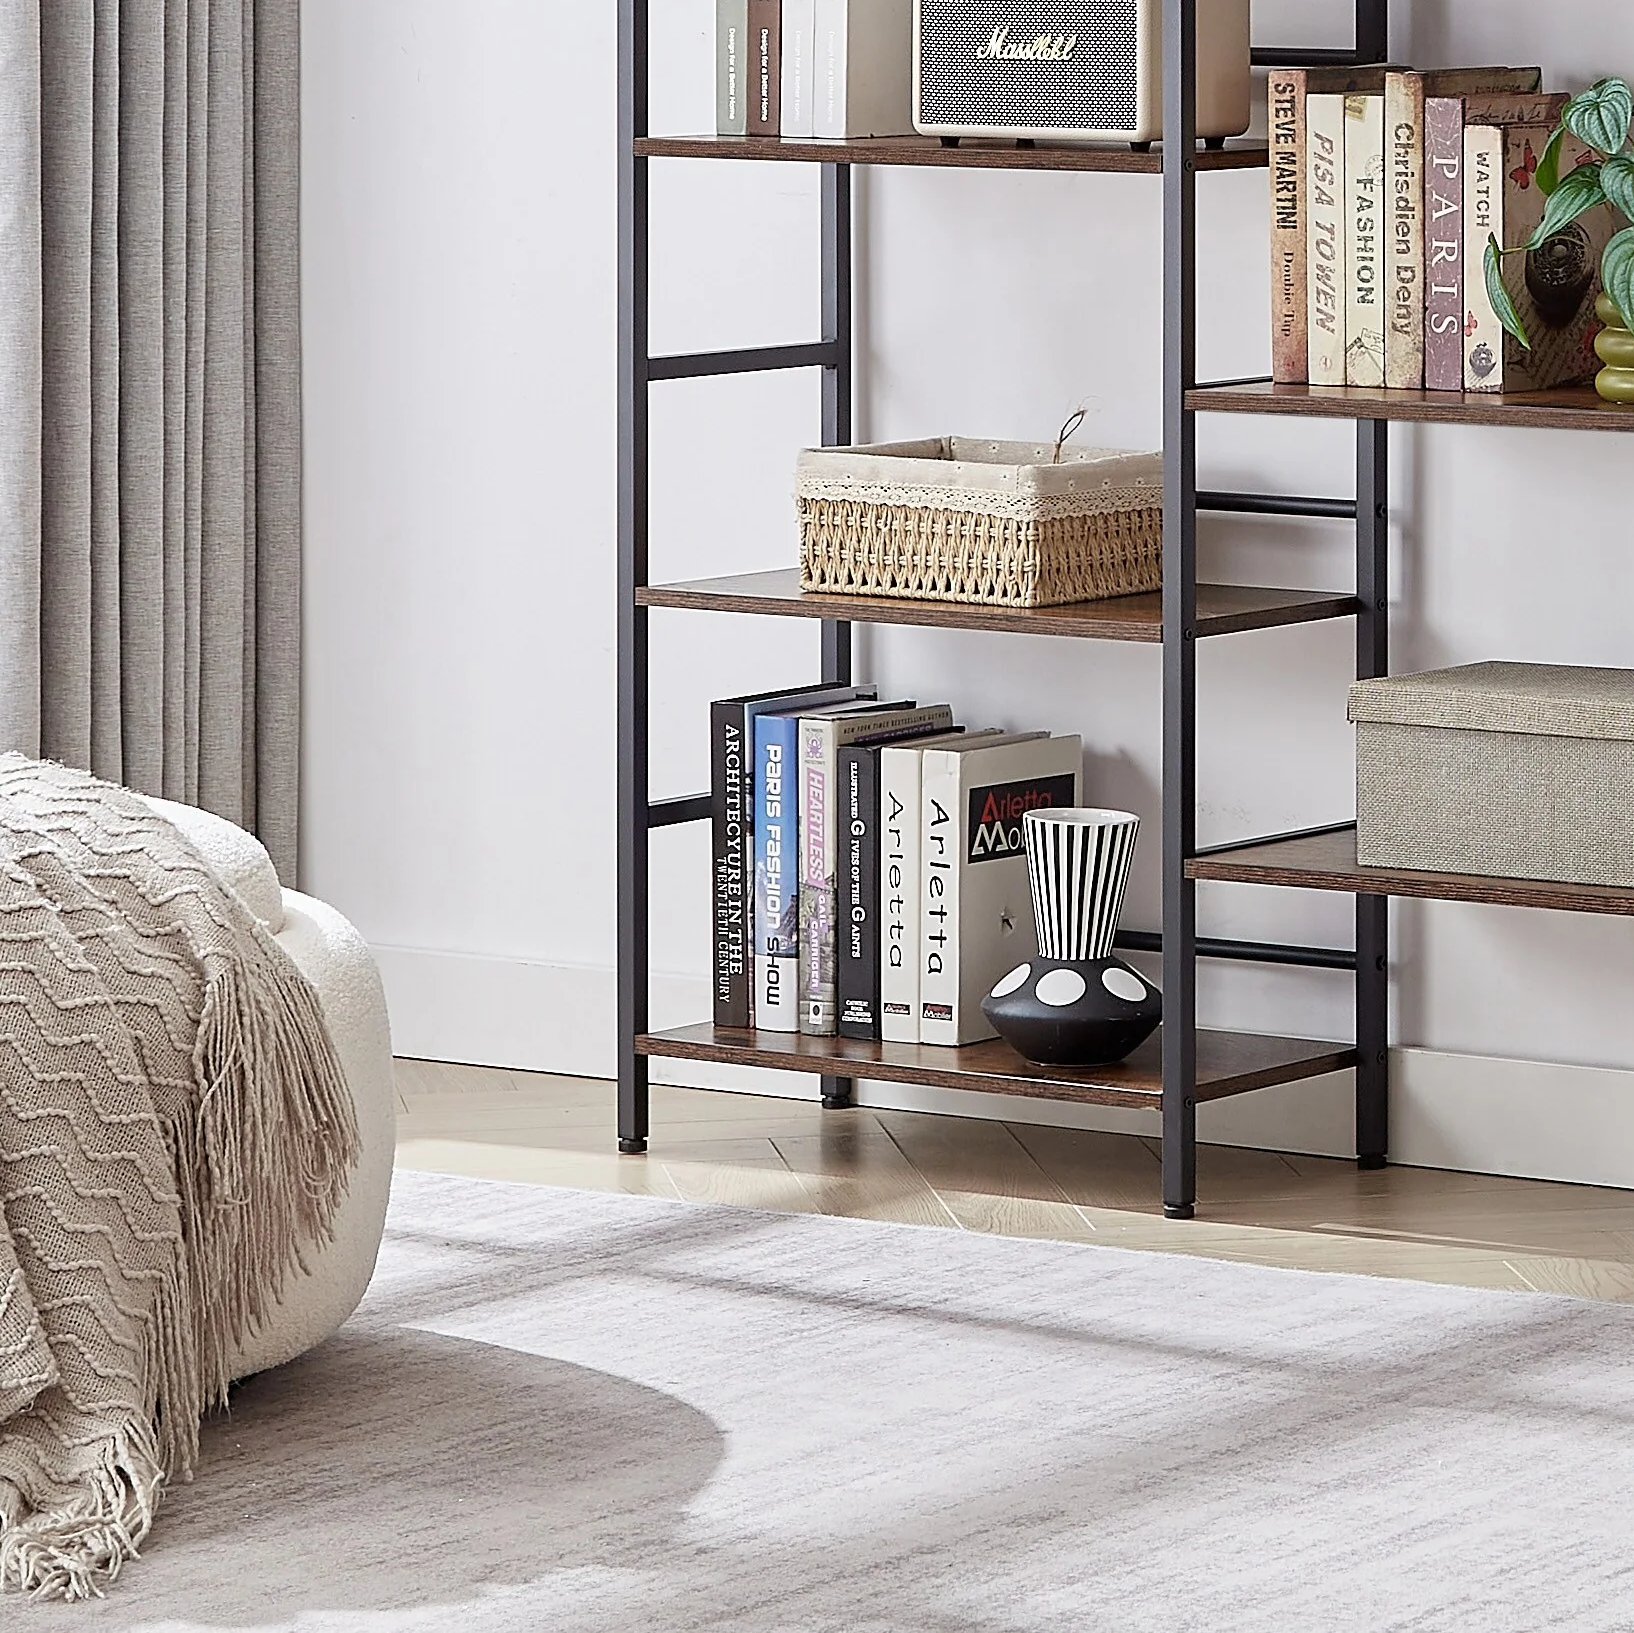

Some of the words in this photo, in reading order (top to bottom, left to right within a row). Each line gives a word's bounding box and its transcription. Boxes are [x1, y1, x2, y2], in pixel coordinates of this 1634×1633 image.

[728, 27, 736, 54] Design
[760, 28, 768, 56] Design
[1273, 82, 1296, 145] STEVE
[1275, 151, 1298, 230] MARTINI
[1313, 130, 1335, 207] PISA
[1394, 122, 1415, 255] Chrisdien
[1476, 151, 1490, 228] WATCH
[1356, 178, 1375, 305] FASHION
[1430, 154, 1459, 335] PARIS
[1391, 265, 1416, 337] Deny
[809, 772, 824, 881] HEARTLESS
[981, 788, 1052, 823] Arletta
[851, 867, 860, 882] OF
[851, 882, 860, 905] THE
[888, 790, 904, 968] Arletta
[927, 798, 951, 974] Arletta
[728, 901, 742, 925] IN
[818, 894, 828, 928] GAIL
[718, 939, 730, 1003] CENTURY
[728, 929, 743, 975] THE
